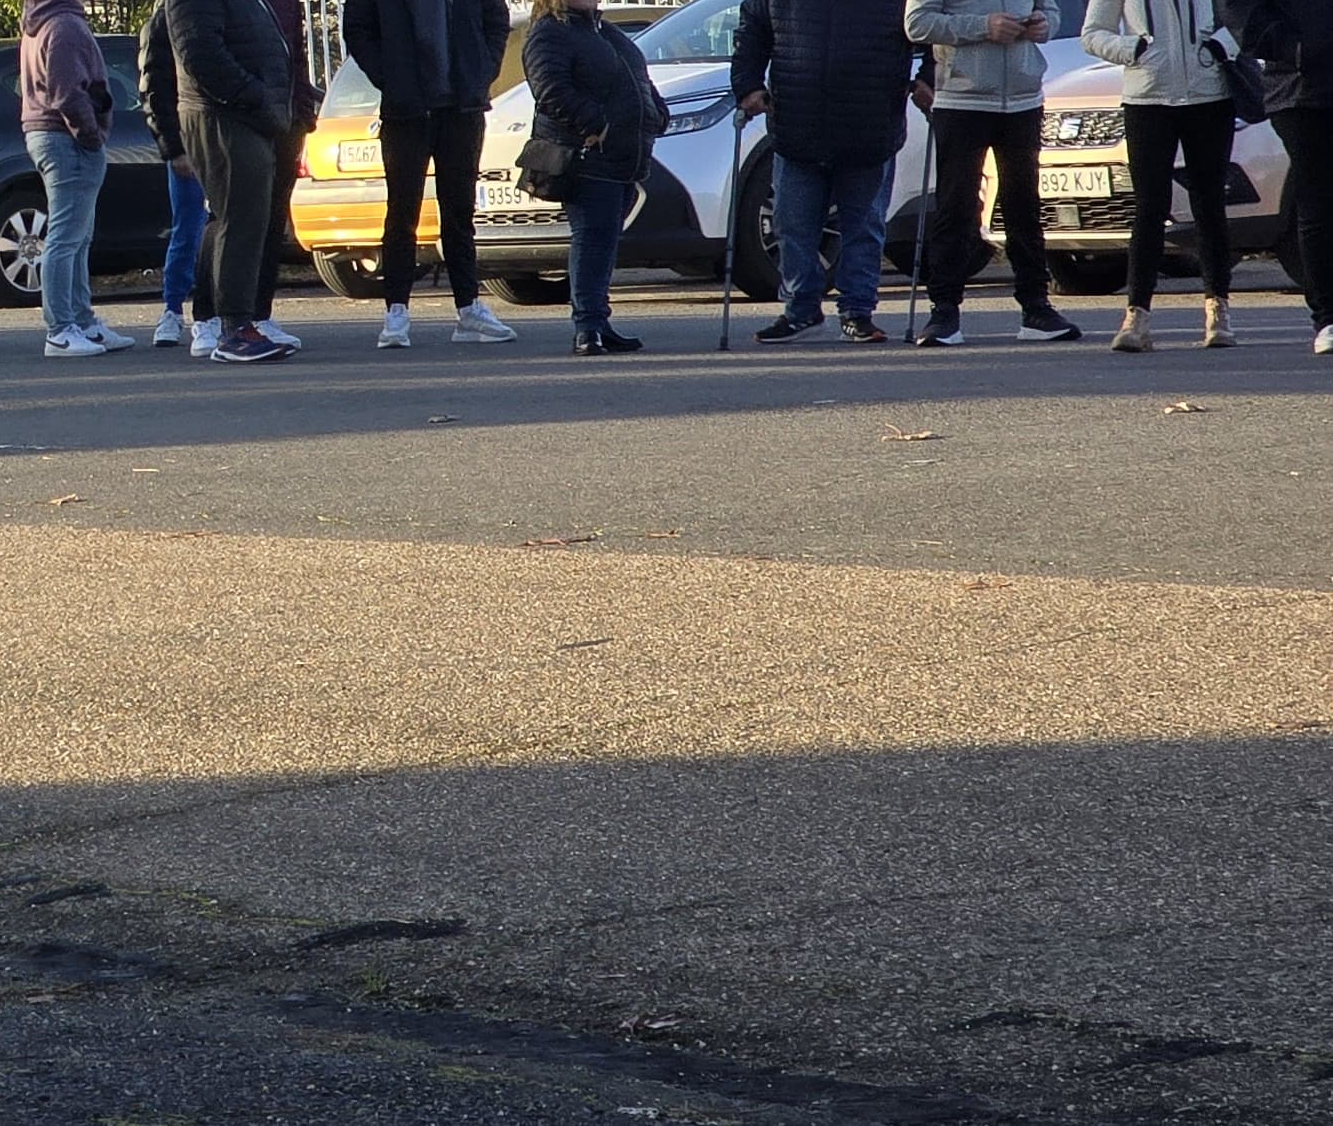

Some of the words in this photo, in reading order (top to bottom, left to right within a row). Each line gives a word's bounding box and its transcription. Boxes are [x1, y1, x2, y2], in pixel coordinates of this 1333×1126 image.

[1041, 172, 1069, 192] 892
[1073, 171, 1103, 192] KJY
[488, 186, 522, 205] 9359
